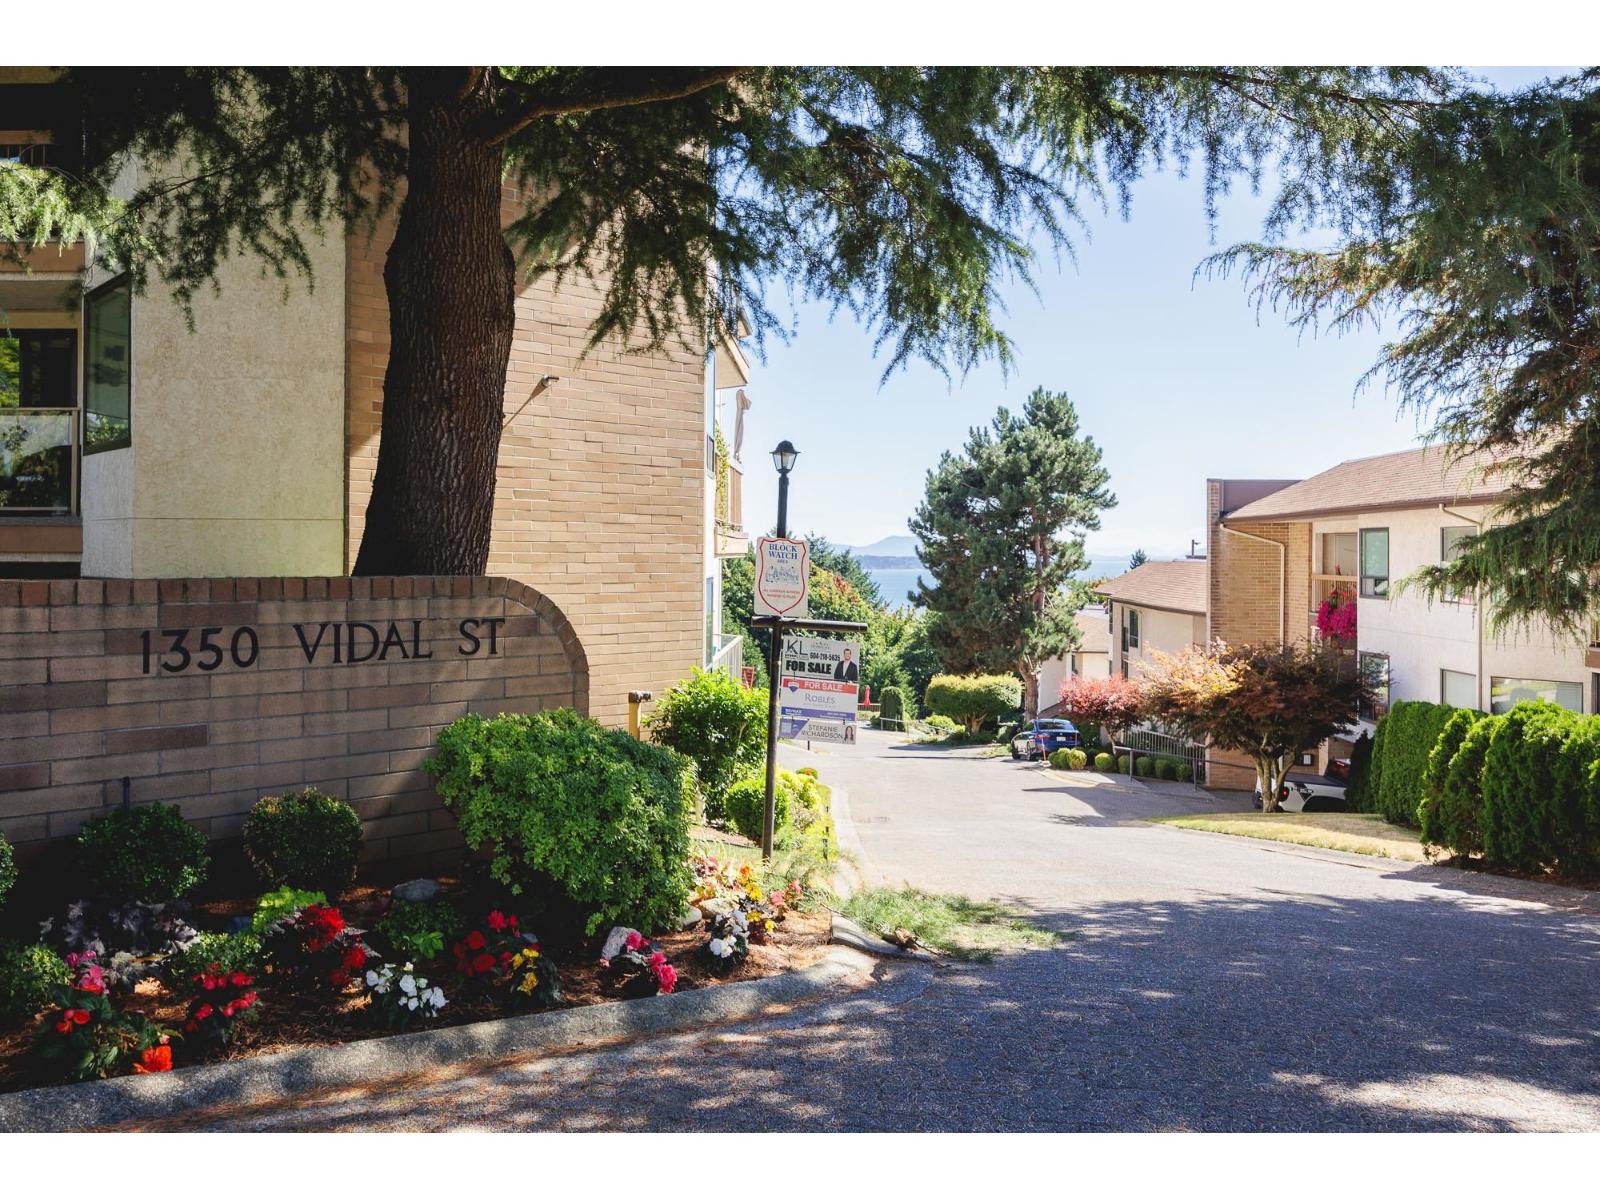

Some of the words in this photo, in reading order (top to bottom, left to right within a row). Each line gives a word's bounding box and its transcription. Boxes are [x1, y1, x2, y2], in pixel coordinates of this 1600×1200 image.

[769, 543, 797, 552] BLOCK
[769, 551, 797, 559] WATCH
[139, 626, 259, 674] 1350
[293, 620, 433, 664] VIDAL
[458, 618, 506, 656] ST
[787, 640, 808, 655] KL
[786, 660, 805, 672] FOR
[808, 661, 831, 674] SALE
[804, 681, 821, 690] FOR
[823, 683, 842, 691] SALE
